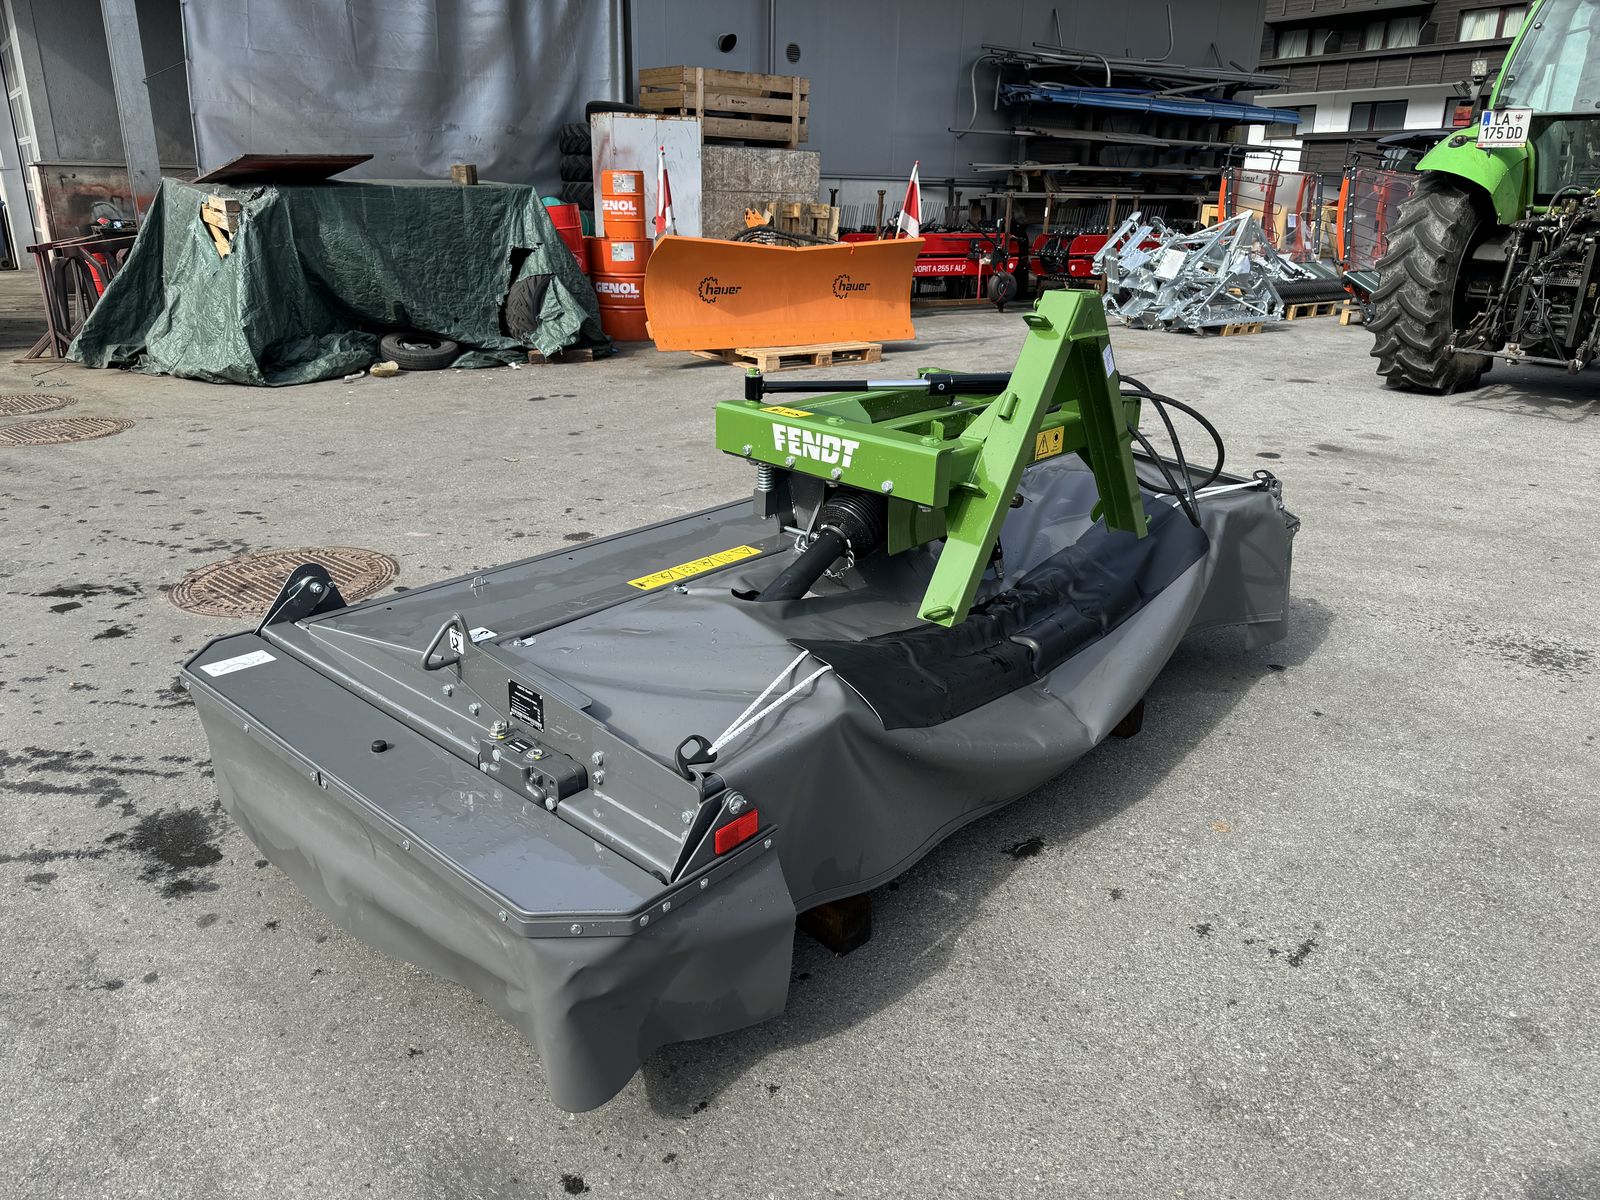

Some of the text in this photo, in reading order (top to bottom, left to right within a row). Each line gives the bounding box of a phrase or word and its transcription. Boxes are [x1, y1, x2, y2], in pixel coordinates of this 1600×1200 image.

[1494, 113, 1510, 126] LA
[1484, 126, 1523, 139] 175 DD
[912, 265, 932, 273] VORIT
[955, 264, 967, 272] ALP
[596, 282, 640, 294] GENOL
[705, 283, 742, 295] hauer
[838, 280, 871, 292] hauer
[772, 423, 860, 468] FENDT
